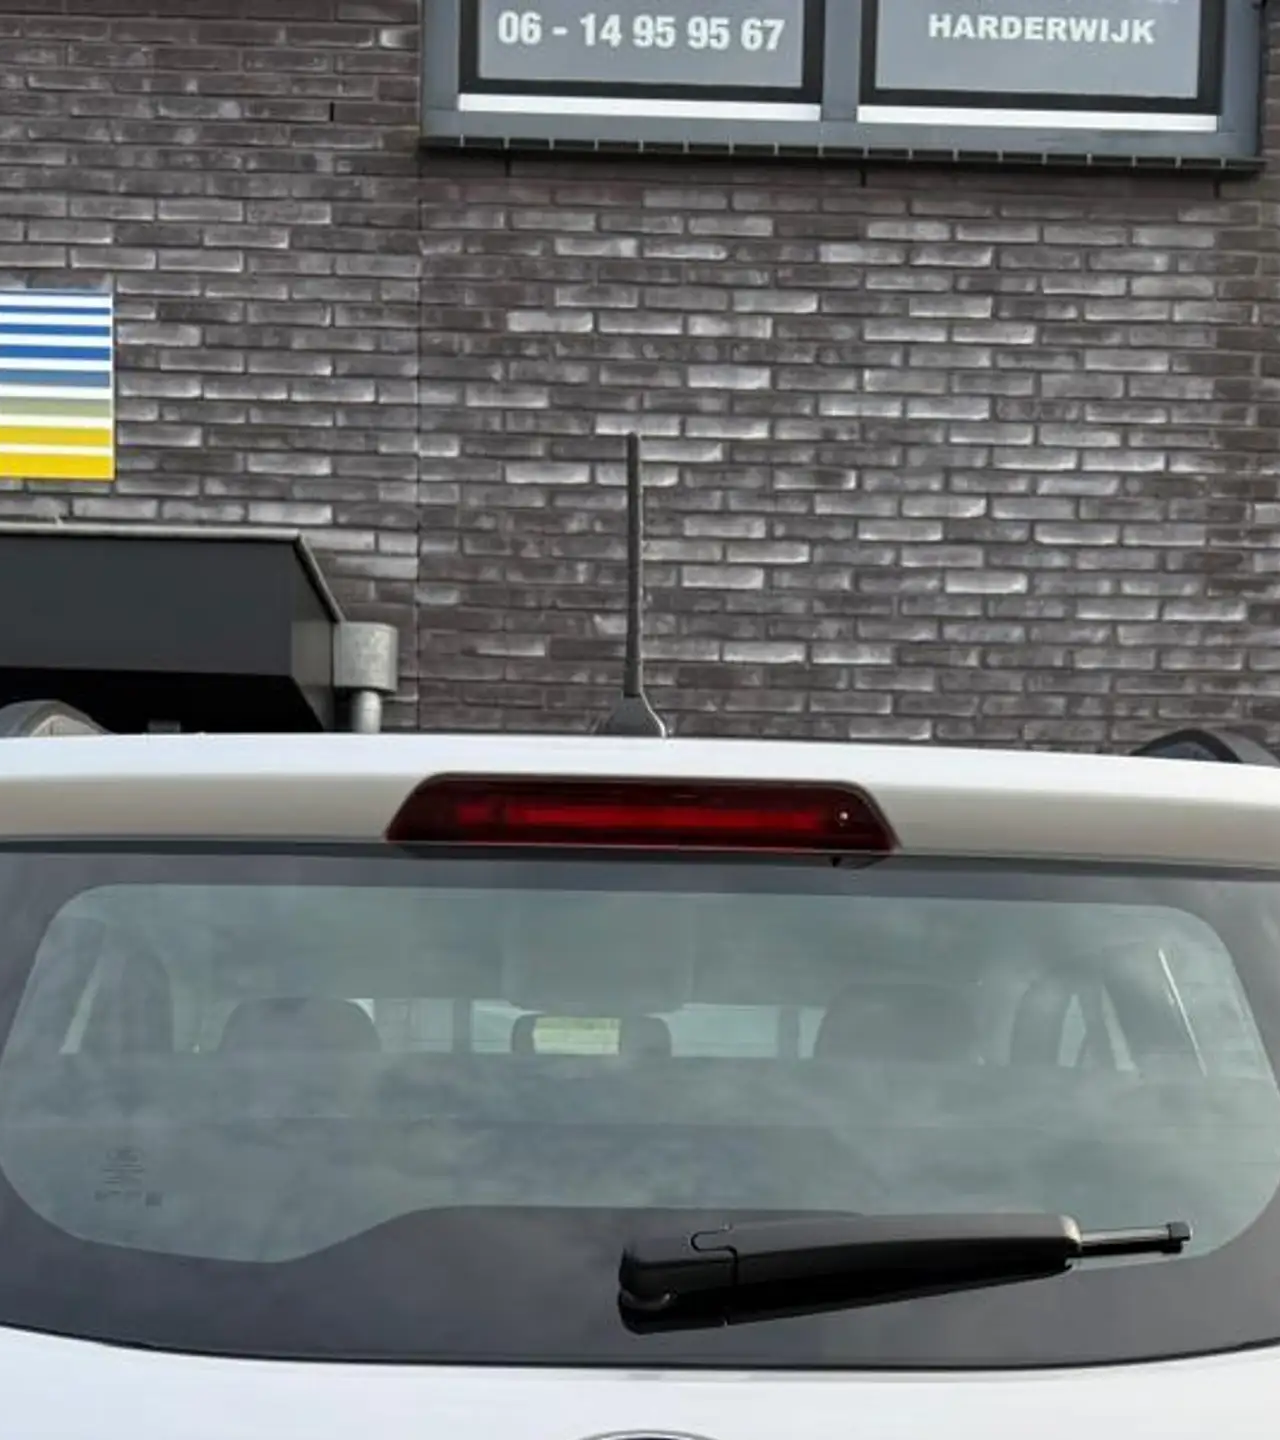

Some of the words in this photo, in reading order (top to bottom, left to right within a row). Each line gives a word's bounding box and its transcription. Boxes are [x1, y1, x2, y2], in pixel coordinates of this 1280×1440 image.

[497, 10, 542, 45] 06
[579, 13, 622, 47] 14
[632, 15, 676, 48] 95
[687, 16, 730, 50] 95
[740, 17, 785, 51] 67
[928, 14, 1156, 44] HARDERWIJK
